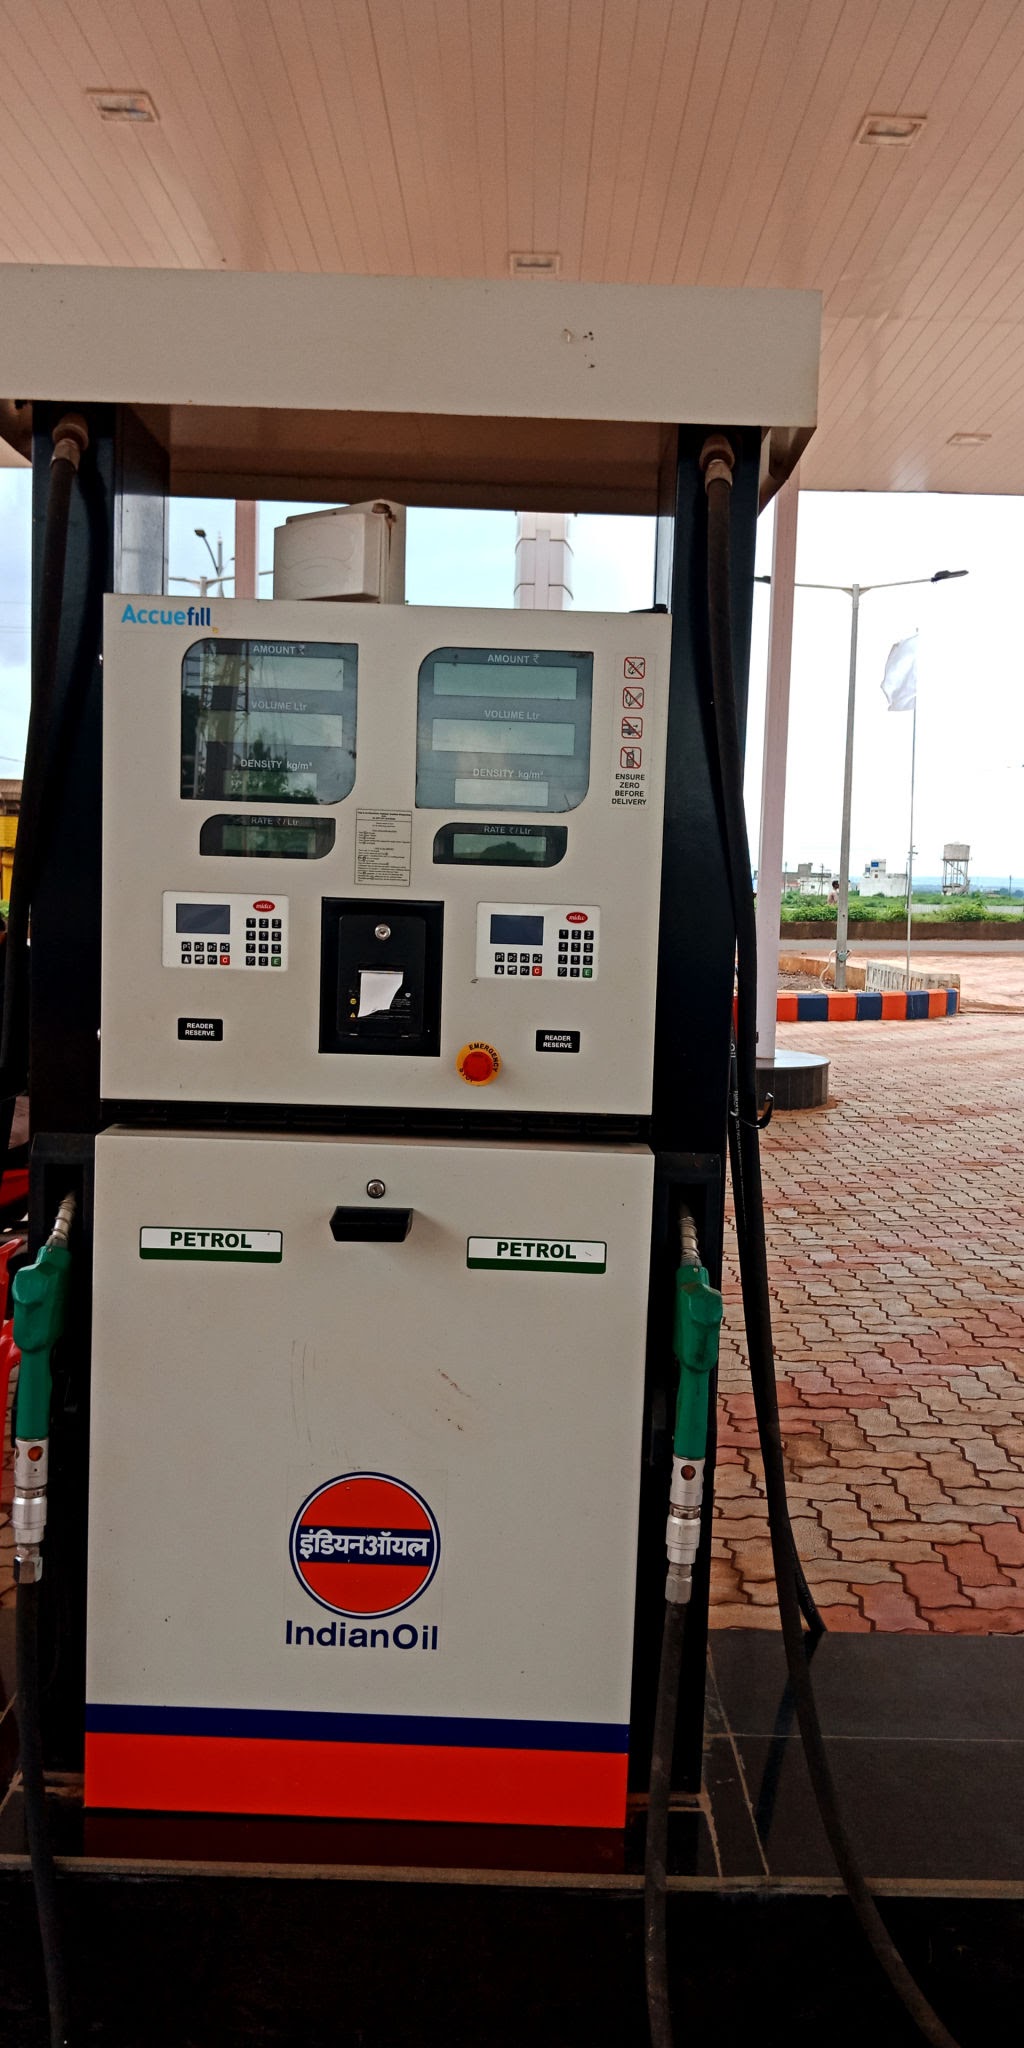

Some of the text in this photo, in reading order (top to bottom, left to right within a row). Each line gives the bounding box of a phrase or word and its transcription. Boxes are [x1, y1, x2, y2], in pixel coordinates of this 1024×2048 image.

[121, 604, 211, 626] Accuefill
[253, 645, 296, 655] AMOUNT
[487, 654, 530, 664] AMOUNT
[251, 701, 308, 711] VOLUME Ltr
[484, 710, 541, 721] VOLUME Ltr
[240, 759, 282, 769] DENSITY
[473, 768, 515, 778] DENSITY
[615, 773, 646, 781] ENSURE
[611, 798, 647, 806] DELIVERY
[251, 816, 273, 825] RATE
[484, 825, 506, 834] RATE
[186, 1022, 214, 1030] READER
[185, 1029, 215, 1037] RESERVE
[544, 1034, 571, 1042] READER
[543, 1041, 573, 1049] RESERVE
[468, 1043, 499, 1073] EMERGENCY
[170, 1231, 252, 1249] PETROL
[497, 1241, 577, 1259] PETROL
[300, 1529, 431, 1559] इंडियनऑयल
[285, 1619, 438, 1650] IndianOil
